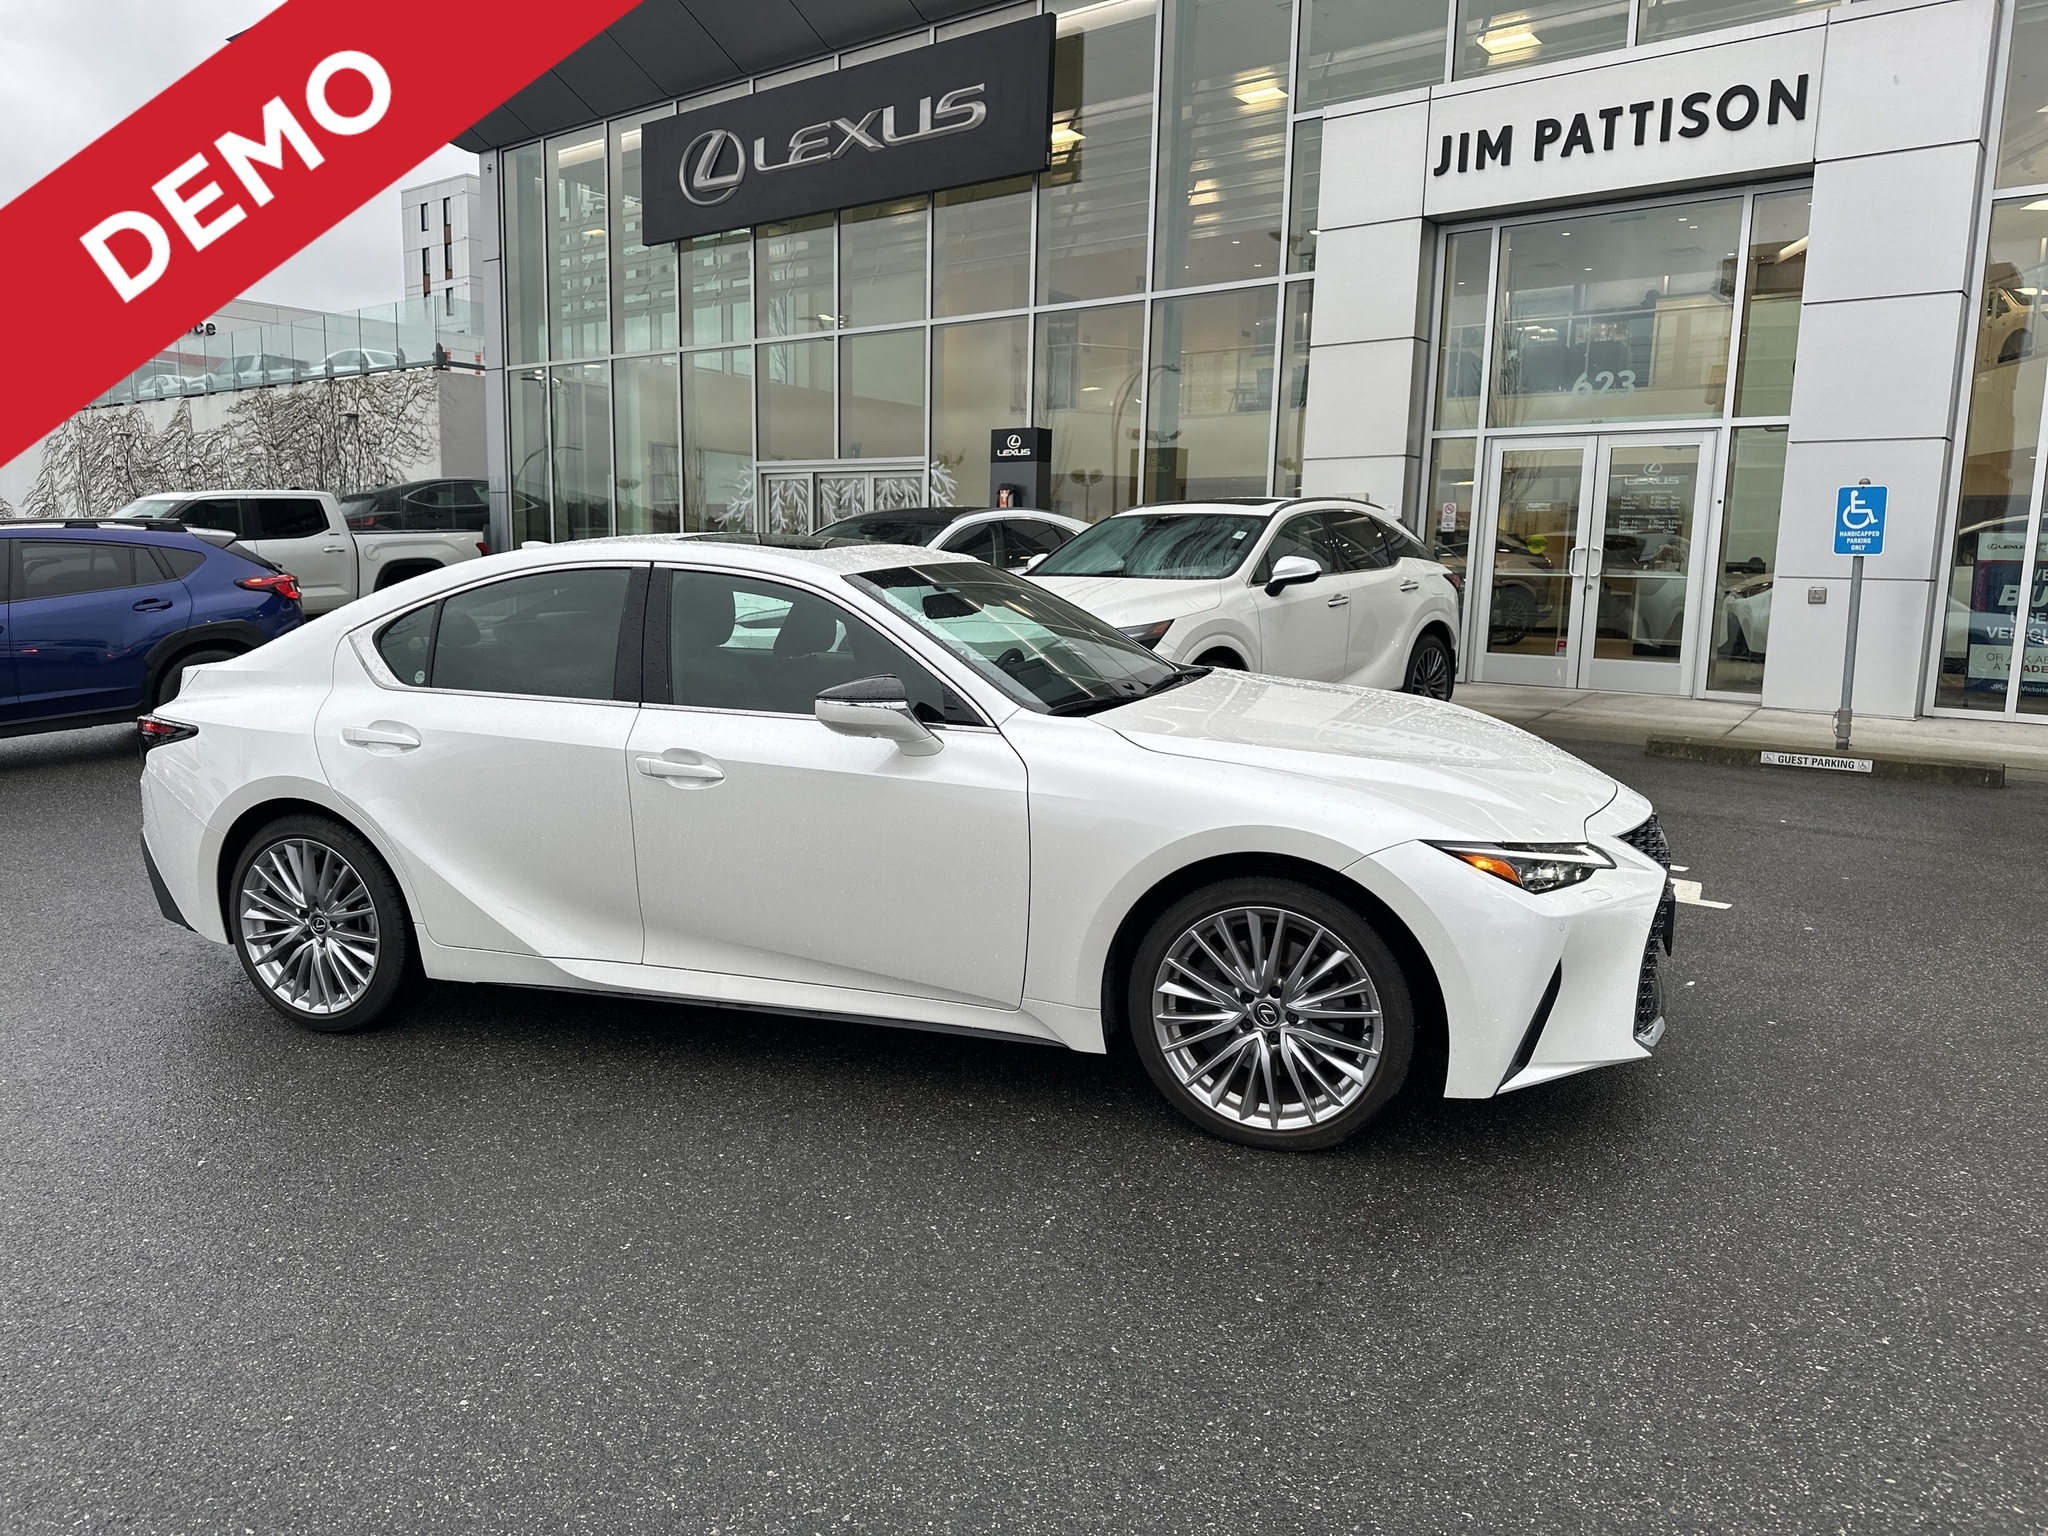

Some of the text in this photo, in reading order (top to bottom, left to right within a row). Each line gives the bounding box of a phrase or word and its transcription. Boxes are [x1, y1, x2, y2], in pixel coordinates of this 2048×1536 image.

[753, 83, 987, 174] LEXUS
[1434, 74, 1808, 176] JIM PATTISON
[1572, 370, 1636, 398] 623
[1624, 476, 1680, 485] LEXUS
[1987, 653, 2003, 662] OR
[1993, 662, 2001, 671] A
[1777, 755, 1855, 769] GUEST PARKING
